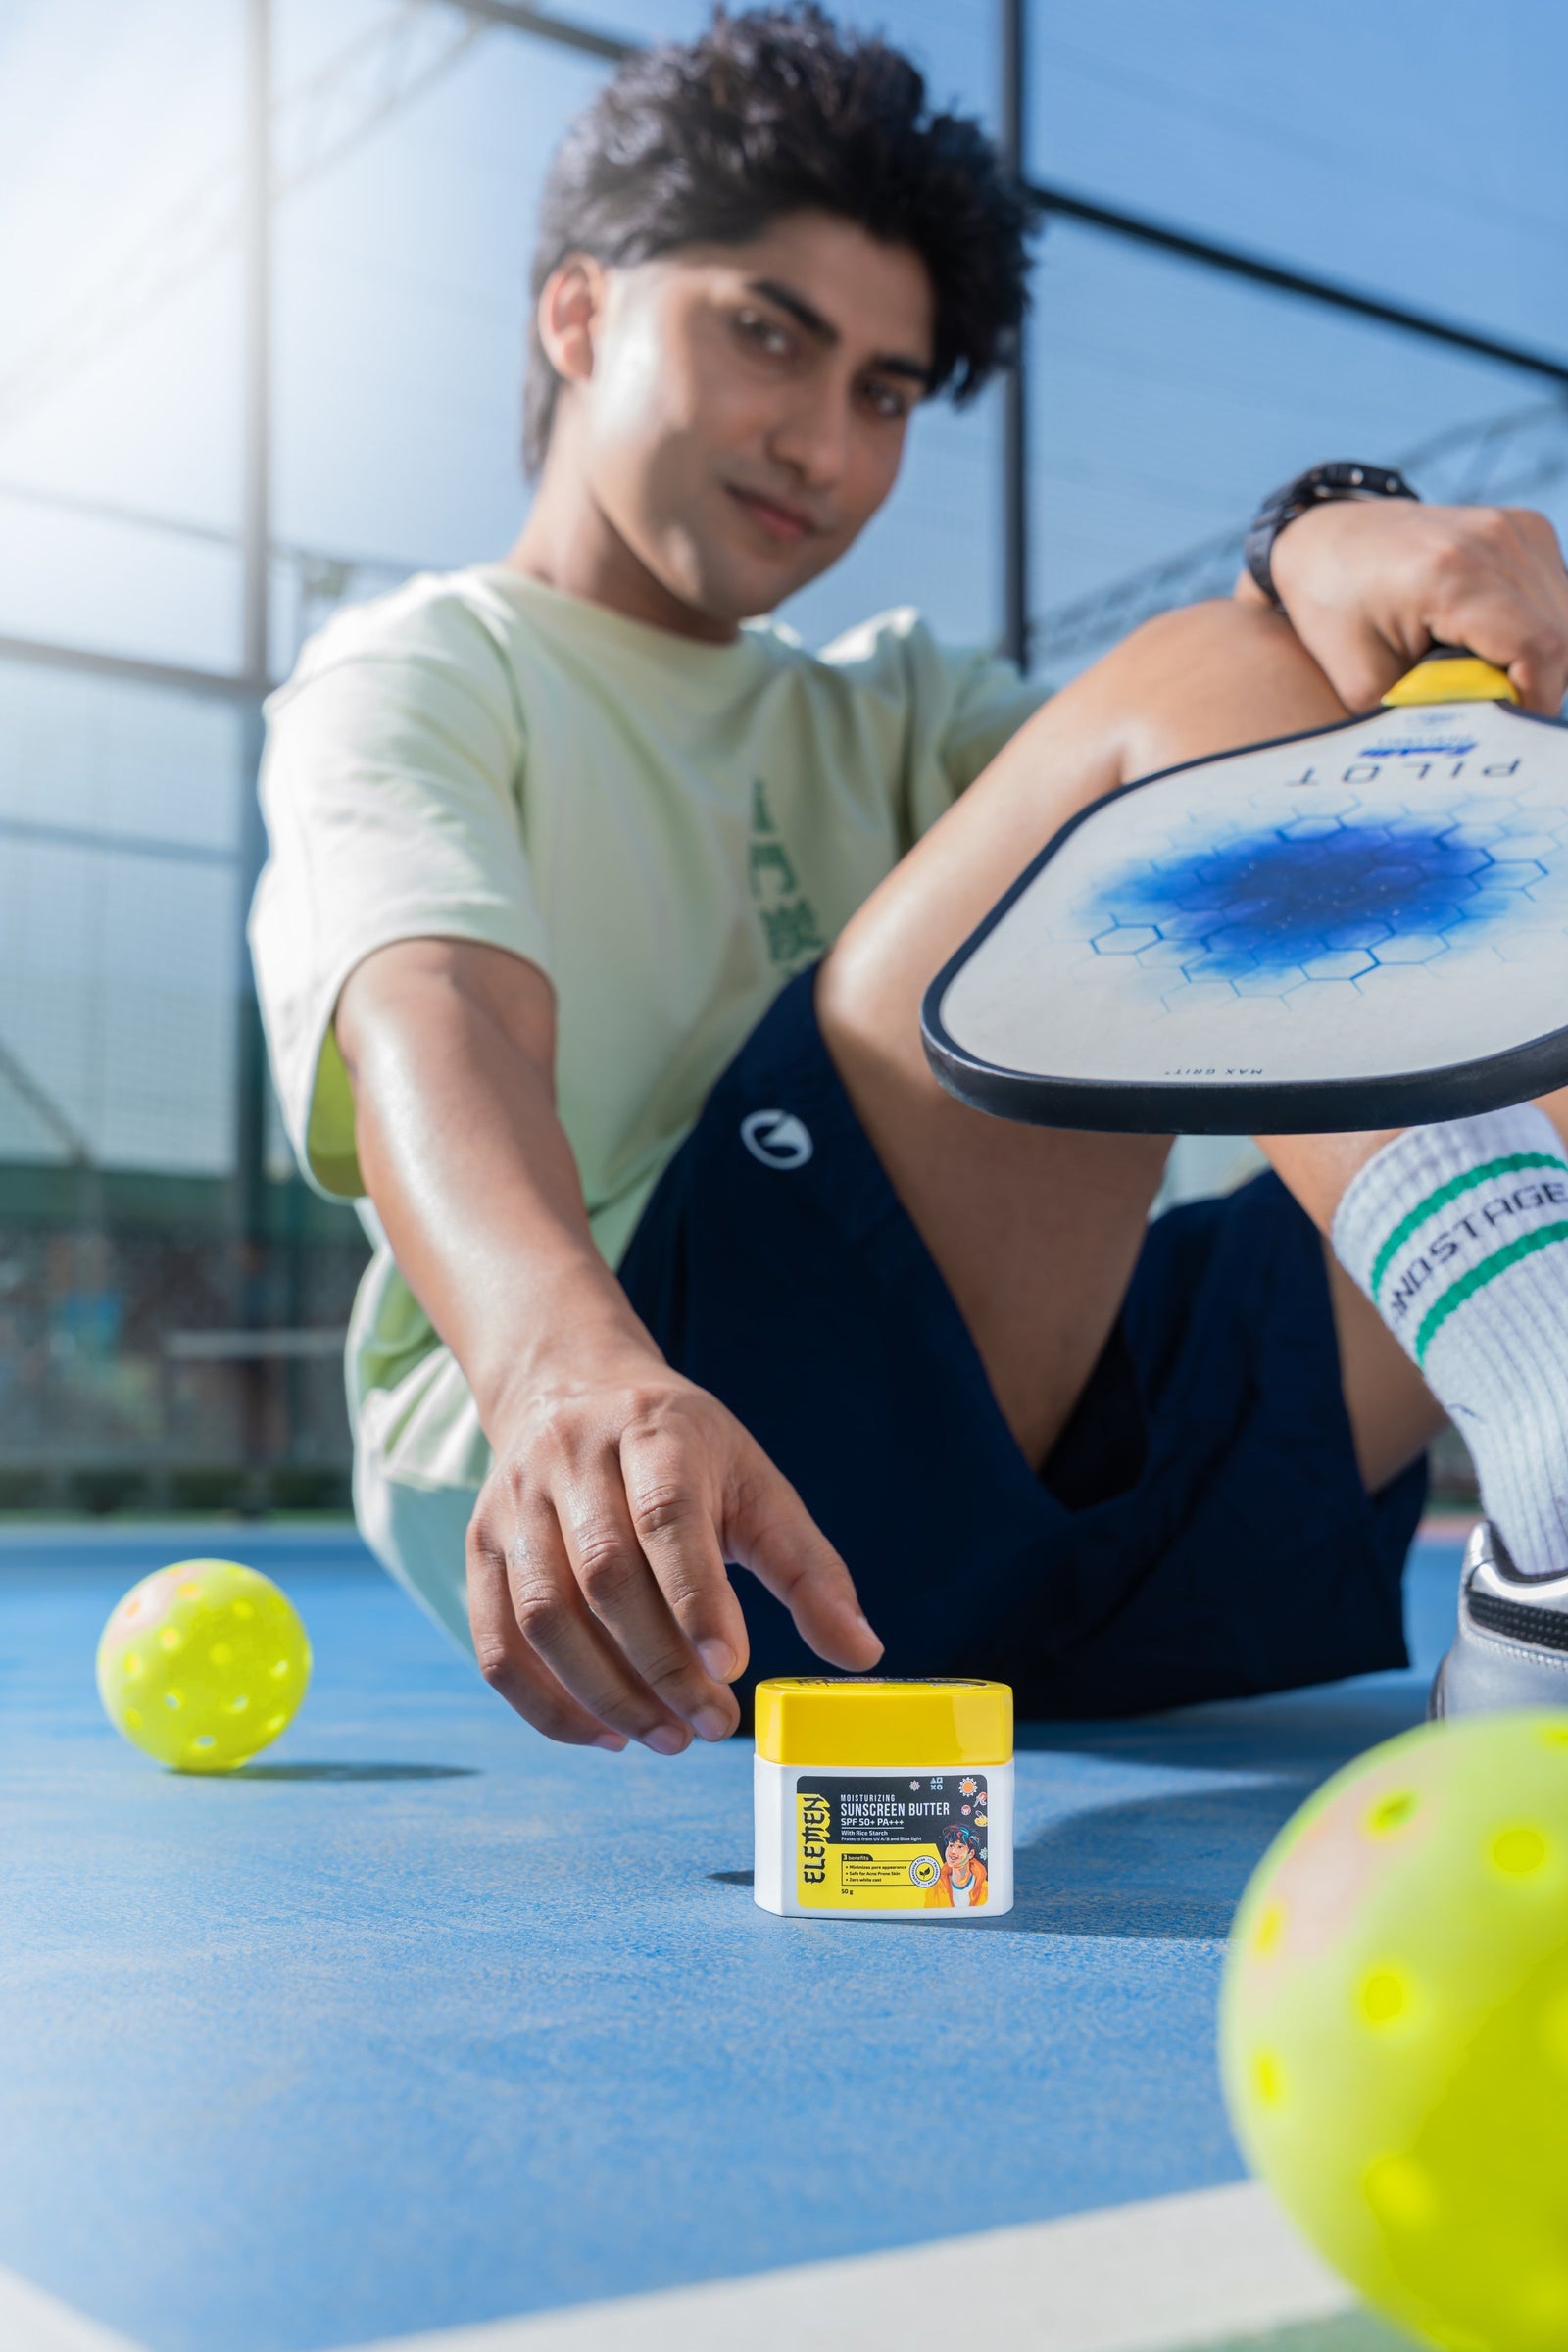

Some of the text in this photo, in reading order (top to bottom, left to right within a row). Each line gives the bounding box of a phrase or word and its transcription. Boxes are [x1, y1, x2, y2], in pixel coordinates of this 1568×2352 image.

[1284, 759, 1521, 786] PILOT
[840, 1802, 950, 1817] SUNSCREEN BUTTER
[801, 1796, 826, 1885] ELEMEN
